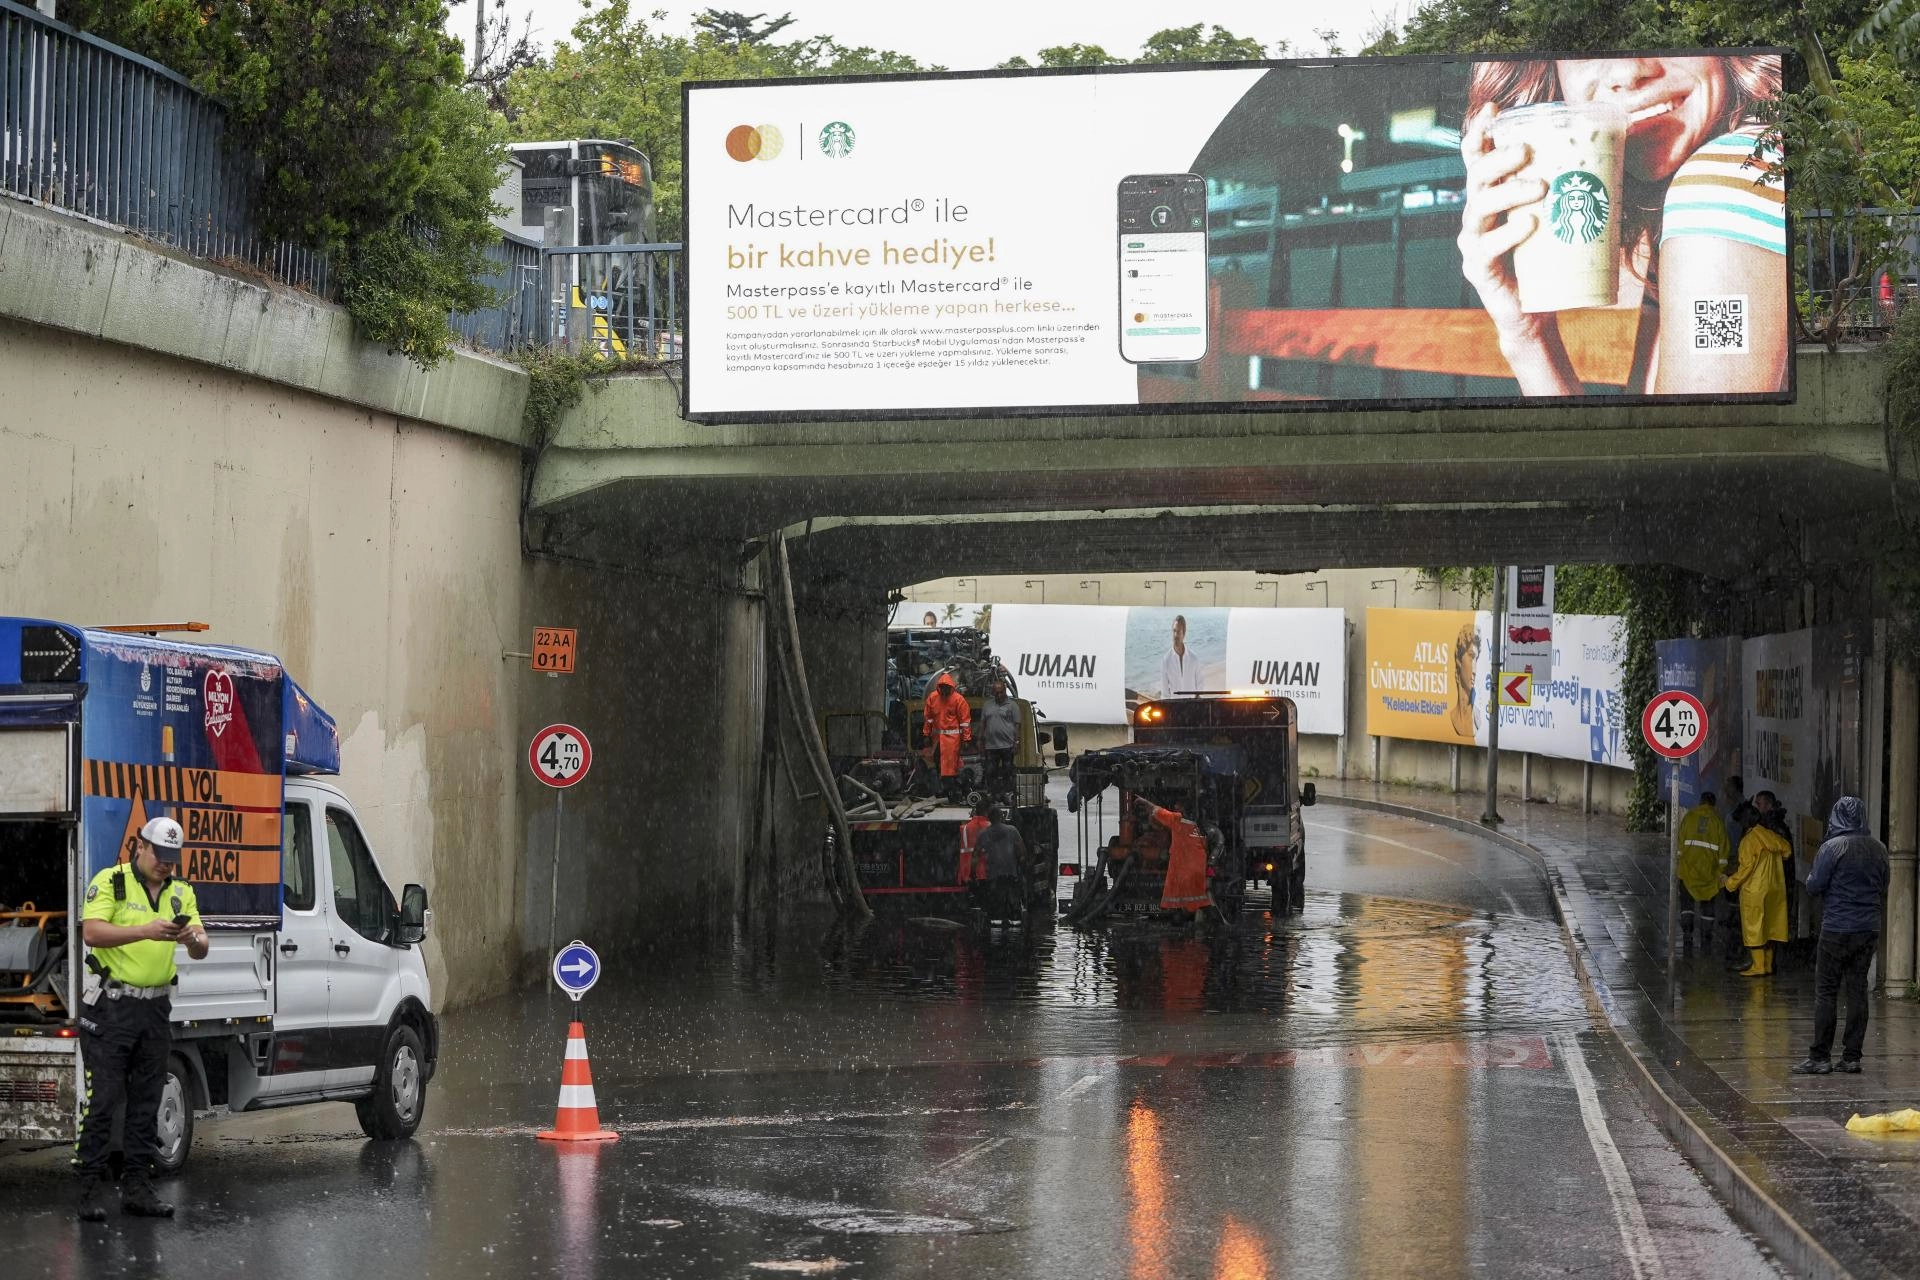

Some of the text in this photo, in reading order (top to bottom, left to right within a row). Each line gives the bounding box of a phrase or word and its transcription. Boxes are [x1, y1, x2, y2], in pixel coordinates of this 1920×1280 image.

[935, 198, 968, 223] ile
[728, 236, 995, 270] bir kahve hediye!
[727, 282, 840, 300] Masterpass'e
[846, 280, 895, 298] kayıtlı
[1014, 276, 1033, 290] ile
[727, 300, 1076, 320] 500 TL ve üzeri yükleme yapan herkese...
[726, 332, 788, 340] Kampanyadan
[890, 328, 917, 336] olarak
[1056, 324, 1100, 332] üzerinden
[922, 338, 947, 346] Mobil
[996, 347, 1032, 355] Yükleme
[773, 363, 826, 372] kapsamında
[884, 360, 916, 370] içeceğe
[918, 360, 952, 368] eşdeğer
[537, 632, 570, 648] 22 AA
[537, 652, 568, 668] 011
[1414, 642, 1448, 664] ATLAS
[1018, 653, 1096, 678] IUMAN
[1250, 660, 1320, 686] IUMAN
[1037, 679, 1096, 690] intimissimi
[1371, 660, 1448, 694] ÜNİVERSİTESİ
[216, 682, 222, 691] 16
[1264, 689, 1320, 698] ntimissimi
[208, 690, 229, 704] MİLYON
[1678, 710, 1692, 720] m
[564, 743, 578, 752] m
[189, 770, 222, 802] YOL
[189, 810, 242, 842] BAKIM
[187, 850, 240, 882] ARACI
